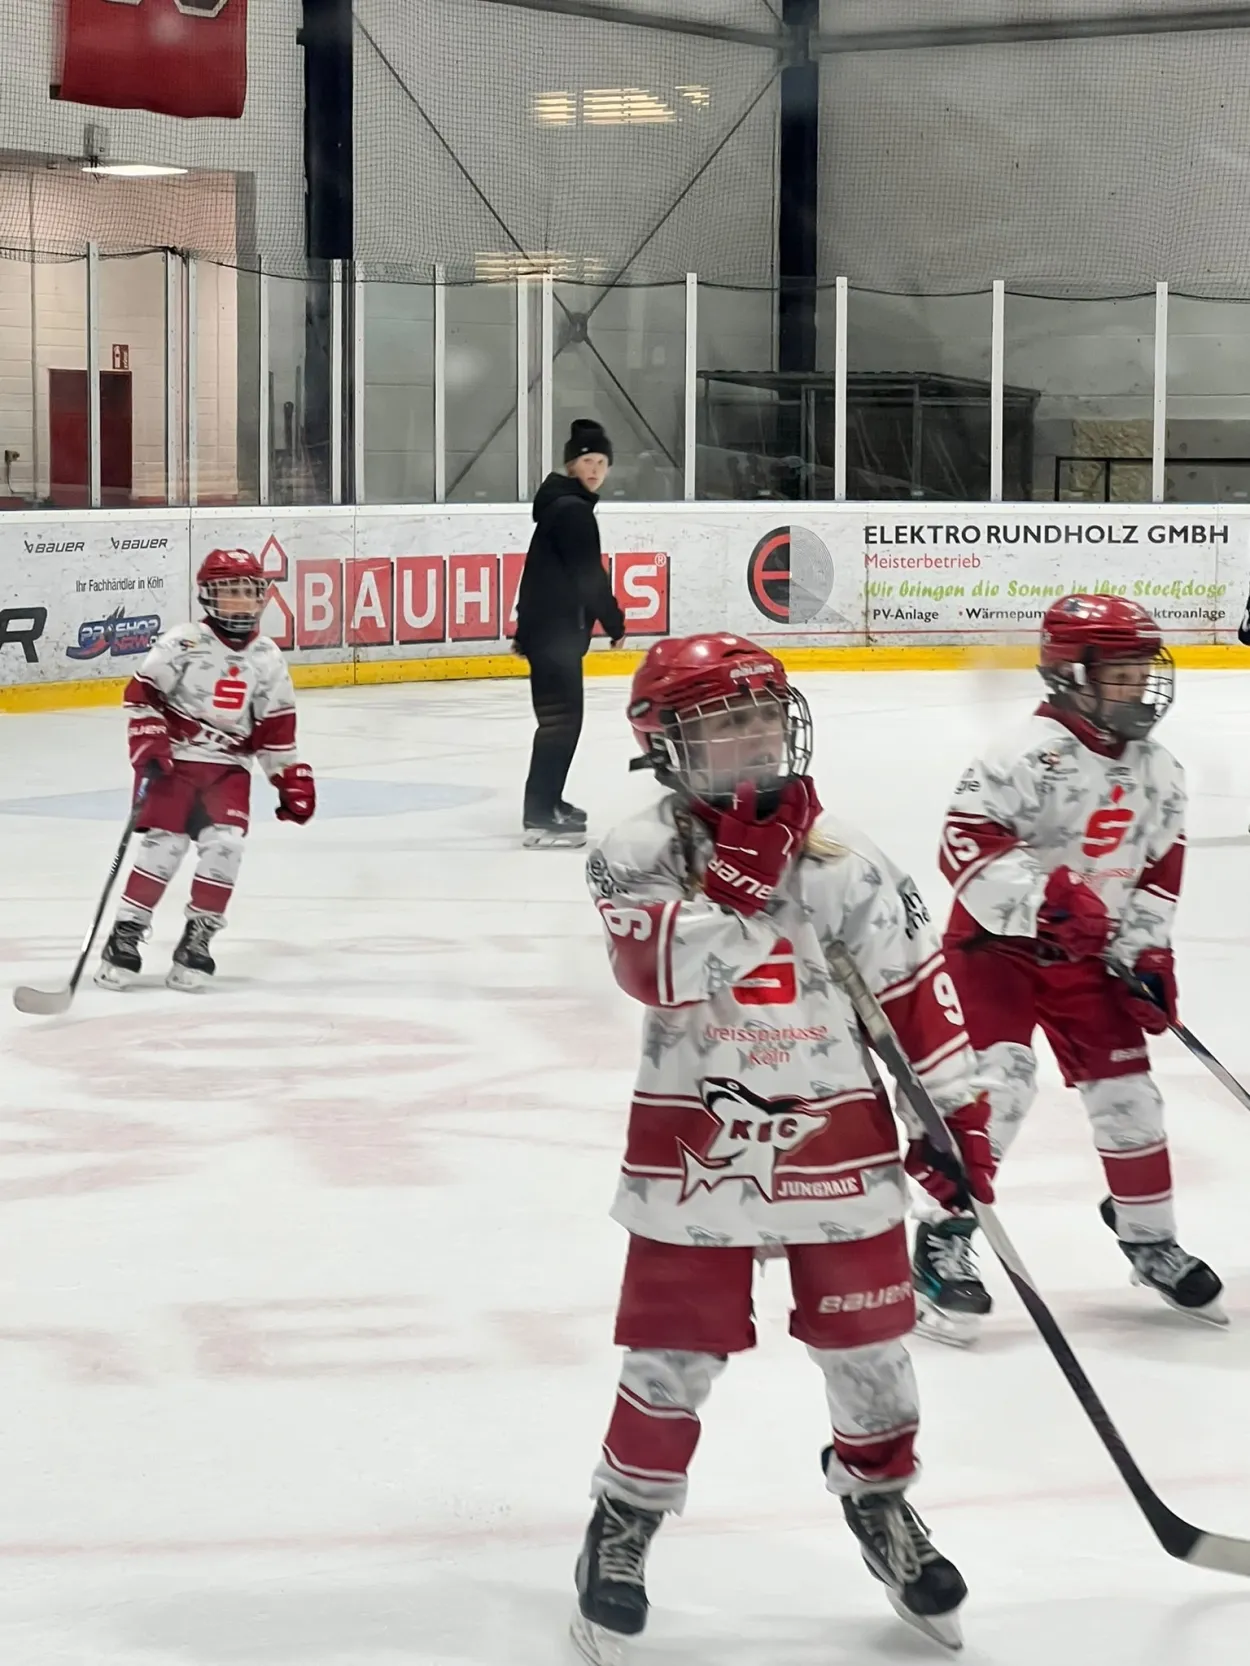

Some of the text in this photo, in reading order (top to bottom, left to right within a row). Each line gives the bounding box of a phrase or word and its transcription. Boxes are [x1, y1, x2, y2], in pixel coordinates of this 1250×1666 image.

[864, 525, 1229, 544] ELEKTRO RUNDHOLZ GMBH
[34, 541, 85, 553] BAUER
[121, 538, 168, 550] BAUER
[864, 553, 981, 568] Meisterbetrieb
[75, 576, 164, 592] Ihr Fachhändler in Köln
[864, 580, 894, 597] Wir
[899, 579, 965, 601] bringen
[971, 579, 1000, 597] die
[1006, 579, 1065, 598] Sonne
[1133, 579, 1227, 599] Steckdose
[303, 563, 660, 633] BAUHS
[872, 607, 1227, 623] PV-Anlage Wärmepum ktroanlage
[707, 858, 775, 901] AUER
[932, 971, 965, 1026] 9
